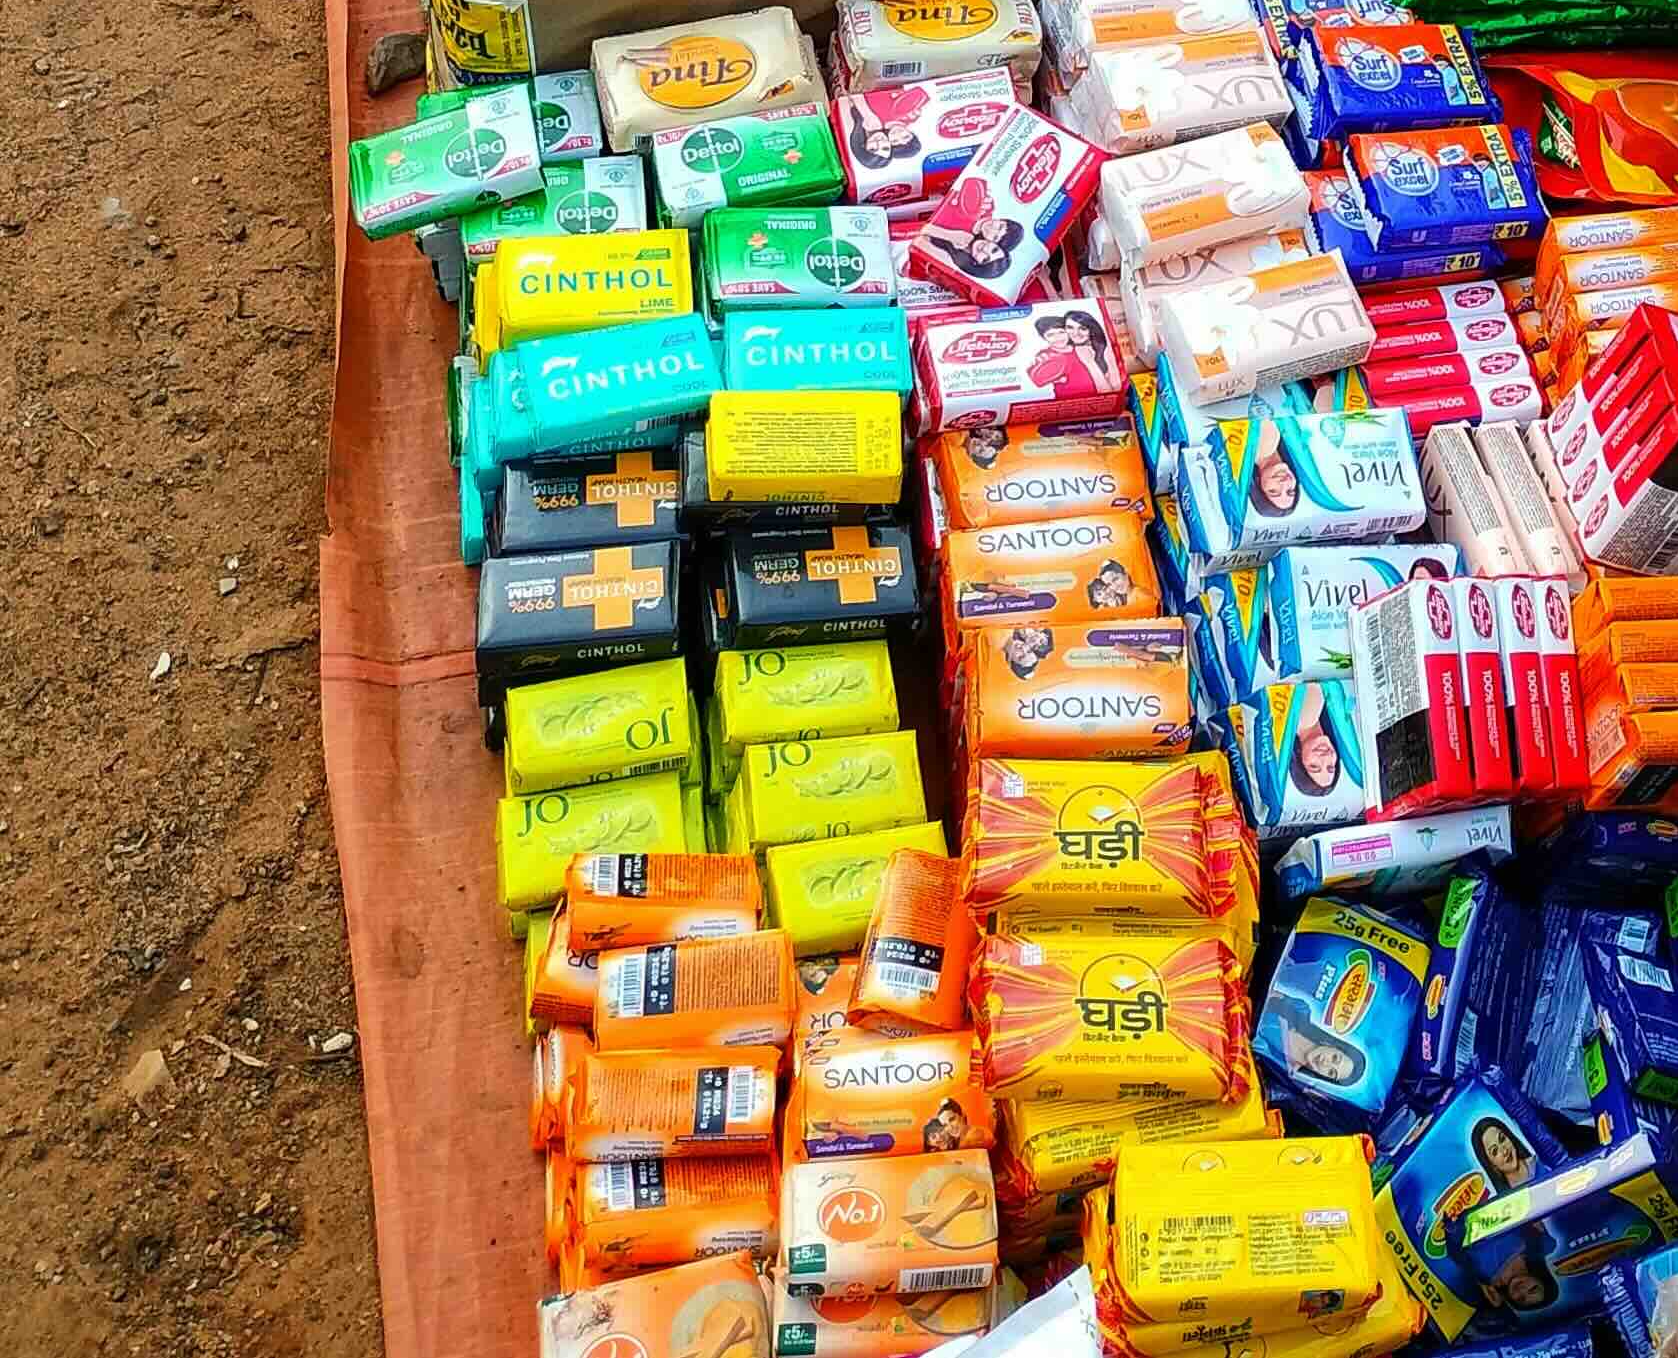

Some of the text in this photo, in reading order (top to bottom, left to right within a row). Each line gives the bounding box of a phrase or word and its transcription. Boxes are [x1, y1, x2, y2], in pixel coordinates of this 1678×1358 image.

[648, 50, 756, 91] Tina
[1352, 51, 1390, 75] Surf
[1358, 67, 1397, 84] excel
[1208, 75, 1286, 109] LUX
[446, 137, 506, 171] Dettol
[683, 139, 741, 166] Dettol
[737, 170, 792, 188] ORIGINAL
[1389, 156, 1427, 181] Surf
[1390, 174, 1431, 189] excel
[557, 203, 618, 225] Dettol
[806, 249, 864, 273] Dettol
[519, 267, 673, 294] CINTHOL
[1579, 267, 1647, 286] SANTOOR
[639, 296, 674, 309] LIME
[1273, 308, 1365, 348] LUX
[745, 341, 898, 366] CINTHOL
[547, 352, 705, 400] CINTHOL
[983, 473, 1117, 502] SANTOOR
[1342, 461, 1408, 488] Vivel
[532, 483, 578, 496] GERM
[776, 502, 840, 518] CINTHOL
[978, 526, 1114, 553] SANTOOR
[807, 557, 899, 577] CINTHOL
[507, 584, 556, 599] GERM
[1305, 579, 1369, 607] Vivel
[823, 619, 888, 633] CINTHOL
[577, 643, 645, 659] CINTHOL
[737, 649, 784, 686] JO
[1017, 694, 1161, 721] SANTOOR
[625, 706, 675, 754] JO
[767, 742, 812, 777] JO
[521, 793, 569, 836] JO
[1052, 820, 1145, 868] घड़ी
[1332, 909, 1412, 956] 25g Free
[1074, 992, 1169, 1042] घड़ी
[824, 1061, 953, 1089] SANTOOR
[828, 1196, 881, 1227] No.1
[1384, 1229, 1419, 1274] Free
